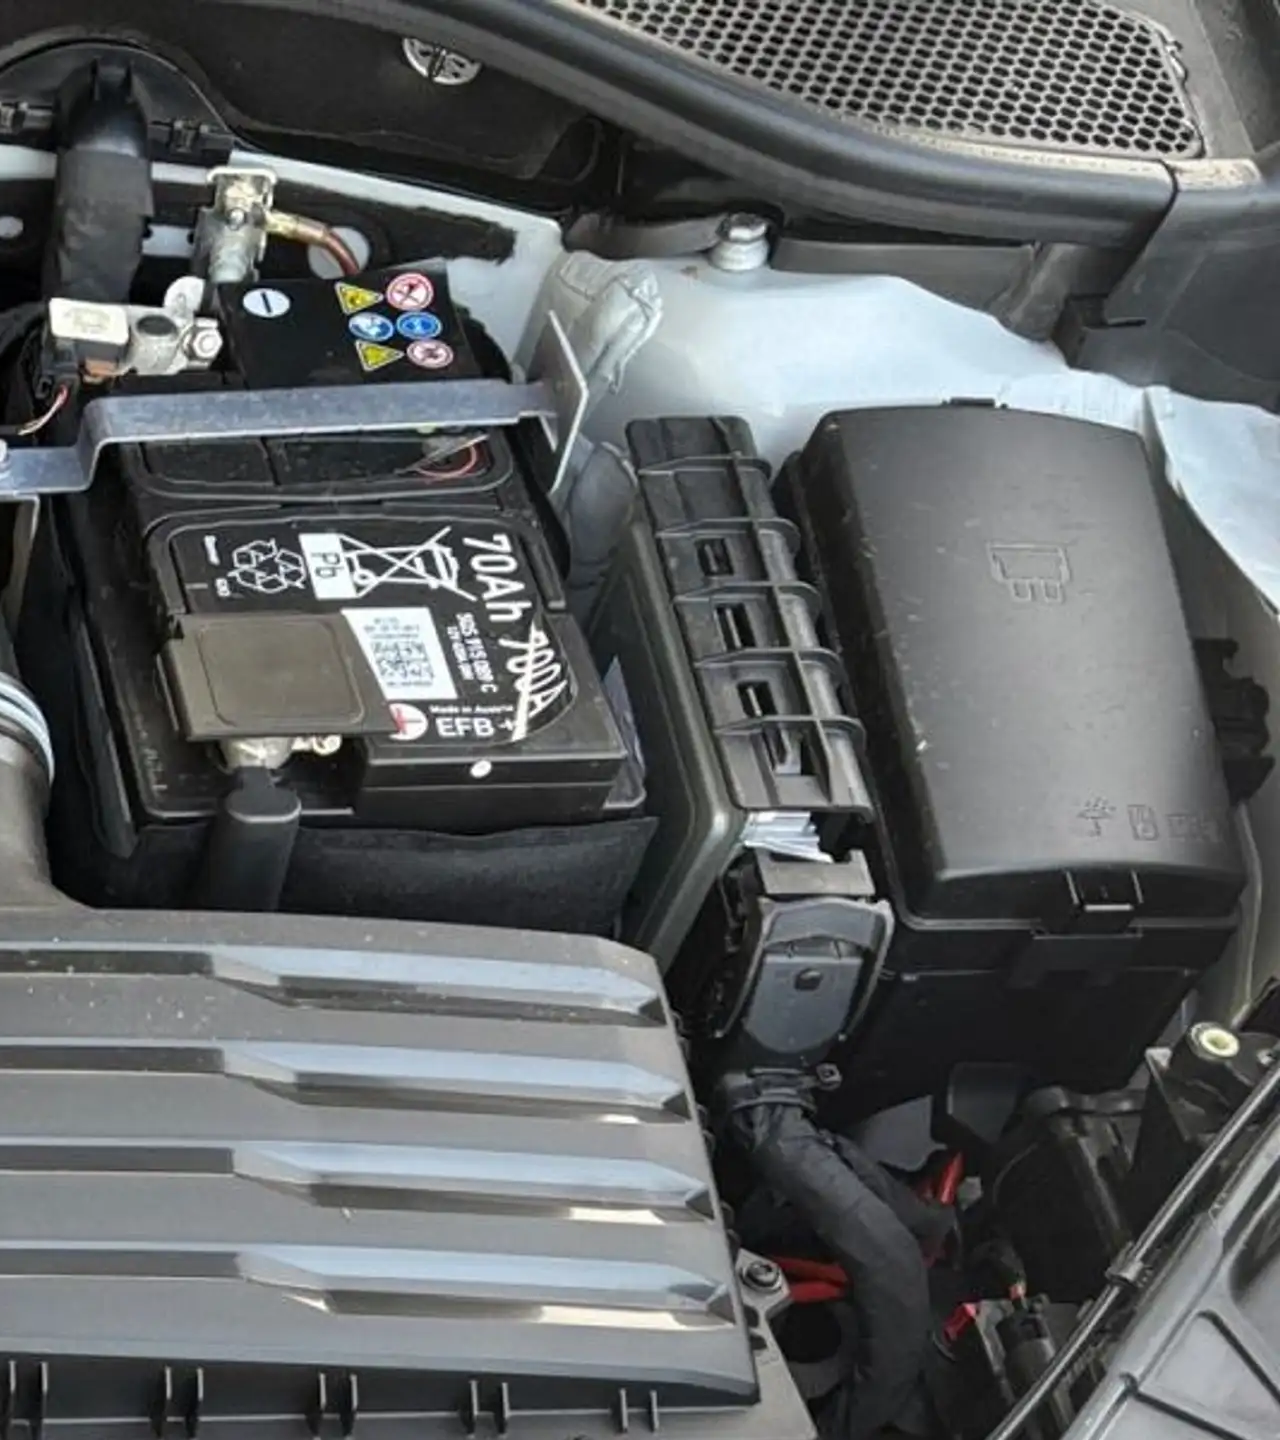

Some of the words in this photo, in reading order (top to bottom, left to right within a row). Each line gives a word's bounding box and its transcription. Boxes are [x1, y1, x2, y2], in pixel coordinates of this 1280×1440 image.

[311, 552, 344, 578] Pb
[462, 533, 532, 622] 70Ah
[436, 717, 496, 737] EFB
